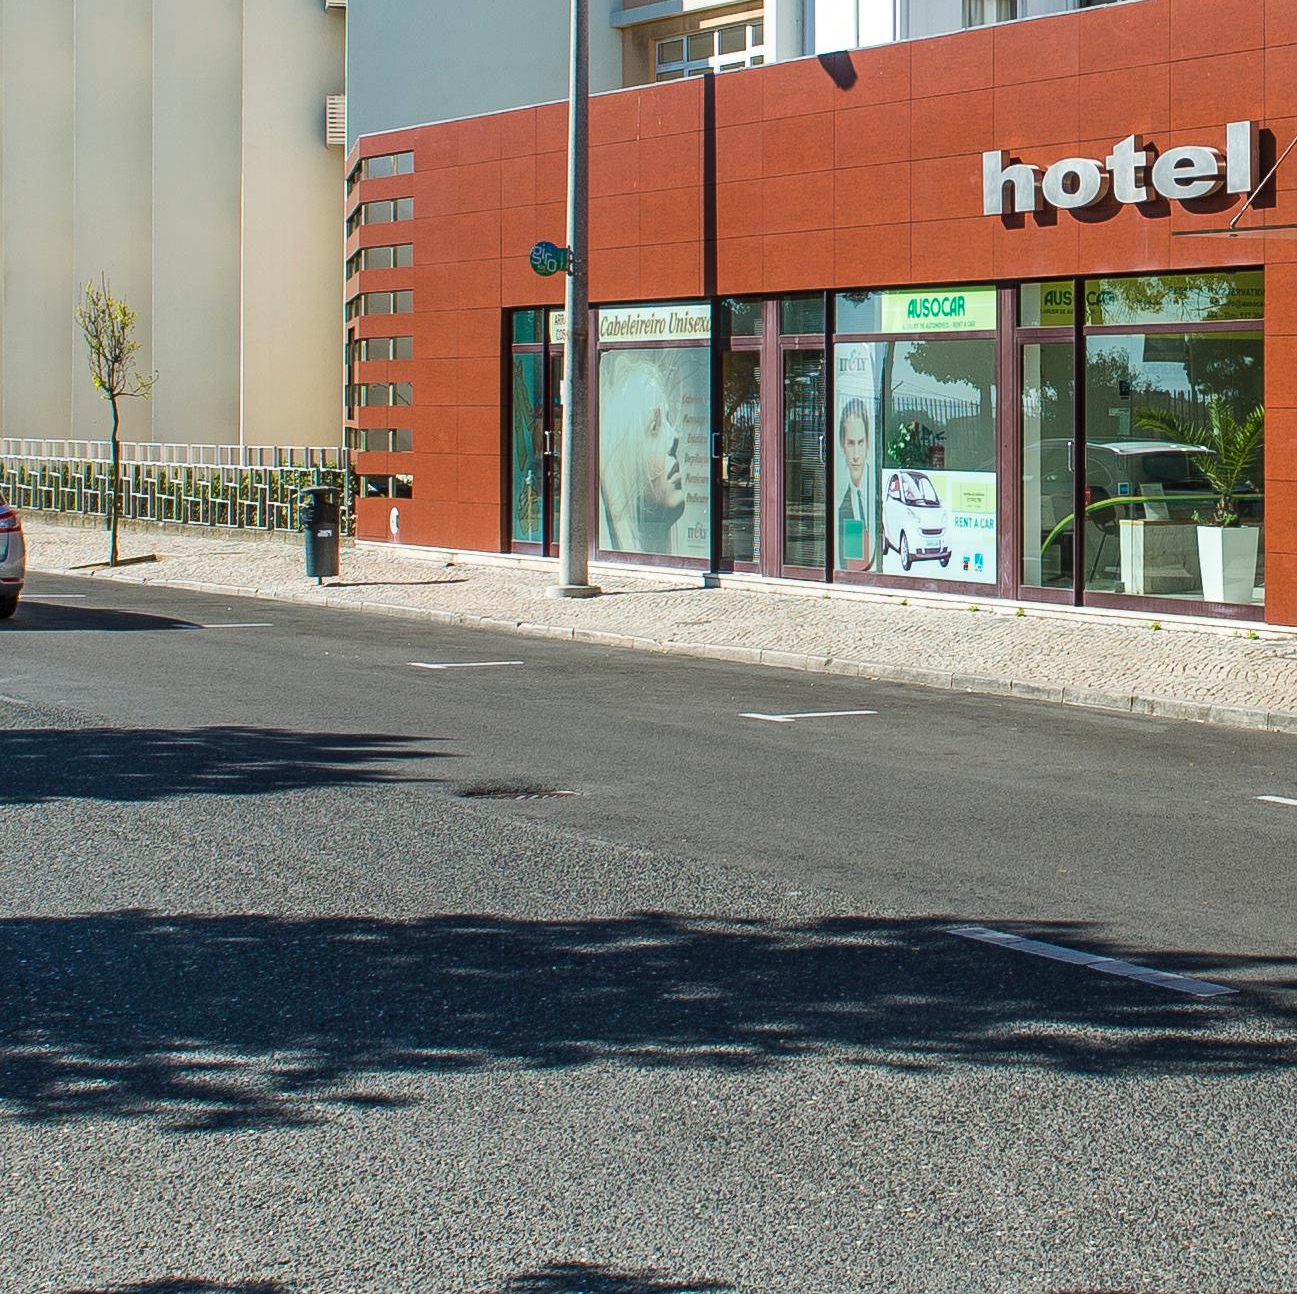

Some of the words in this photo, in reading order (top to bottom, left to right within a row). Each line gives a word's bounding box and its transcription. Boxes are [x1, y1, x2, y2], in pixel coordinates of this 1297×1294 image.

[982, 120, 1257, 216] hotel
[531, 243, 557, 273] giro
[907, 295, 966, 318] AUSOCAR
[600, 312, 666, 337] Cabeleireiro
[955, 516, 972, 528] RENT
[980, 518, 994, 529] CAR
